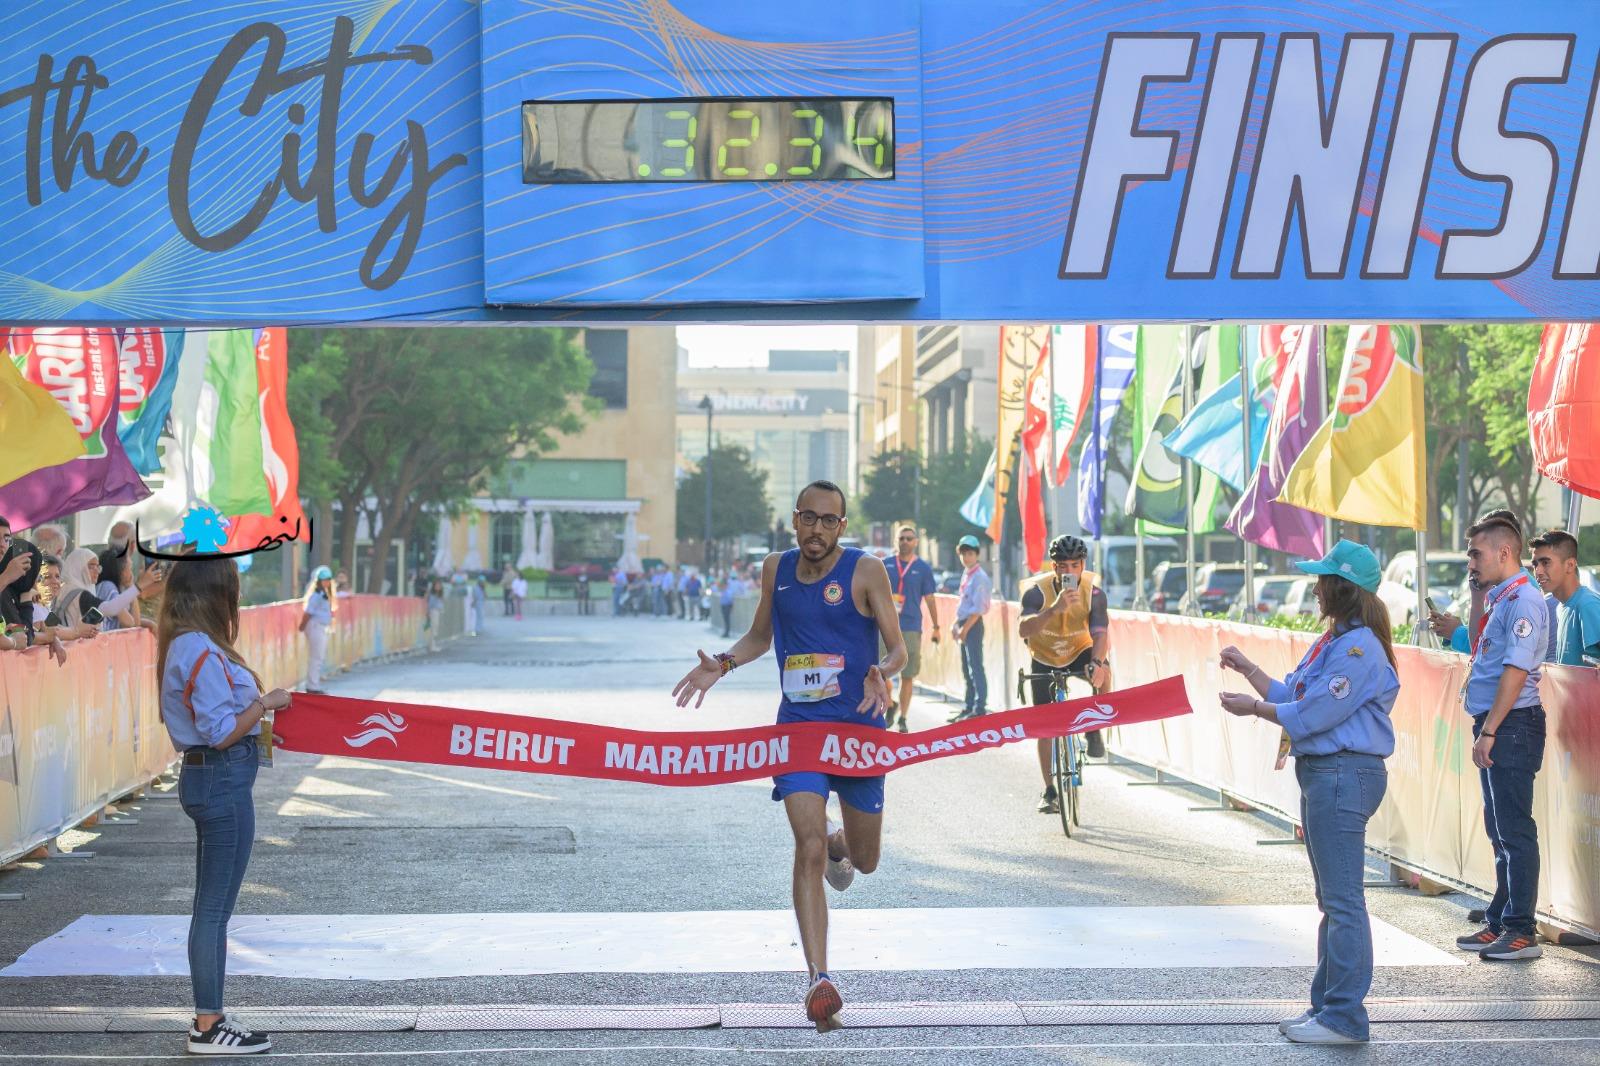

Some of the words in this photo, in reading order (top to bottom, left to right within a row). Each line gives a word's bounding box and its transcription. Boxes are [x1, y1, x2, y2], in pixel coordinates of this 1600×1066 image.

[0, 53, 149, 206] the
[168, 16, 467, 291] City
[804, 673, 820, 685] M1
[450, 724, 575, 765] BEIRUT
[604, 735, 789, 775] MARATHON
[819, 724, 1025, 769] ASSOCIATION
